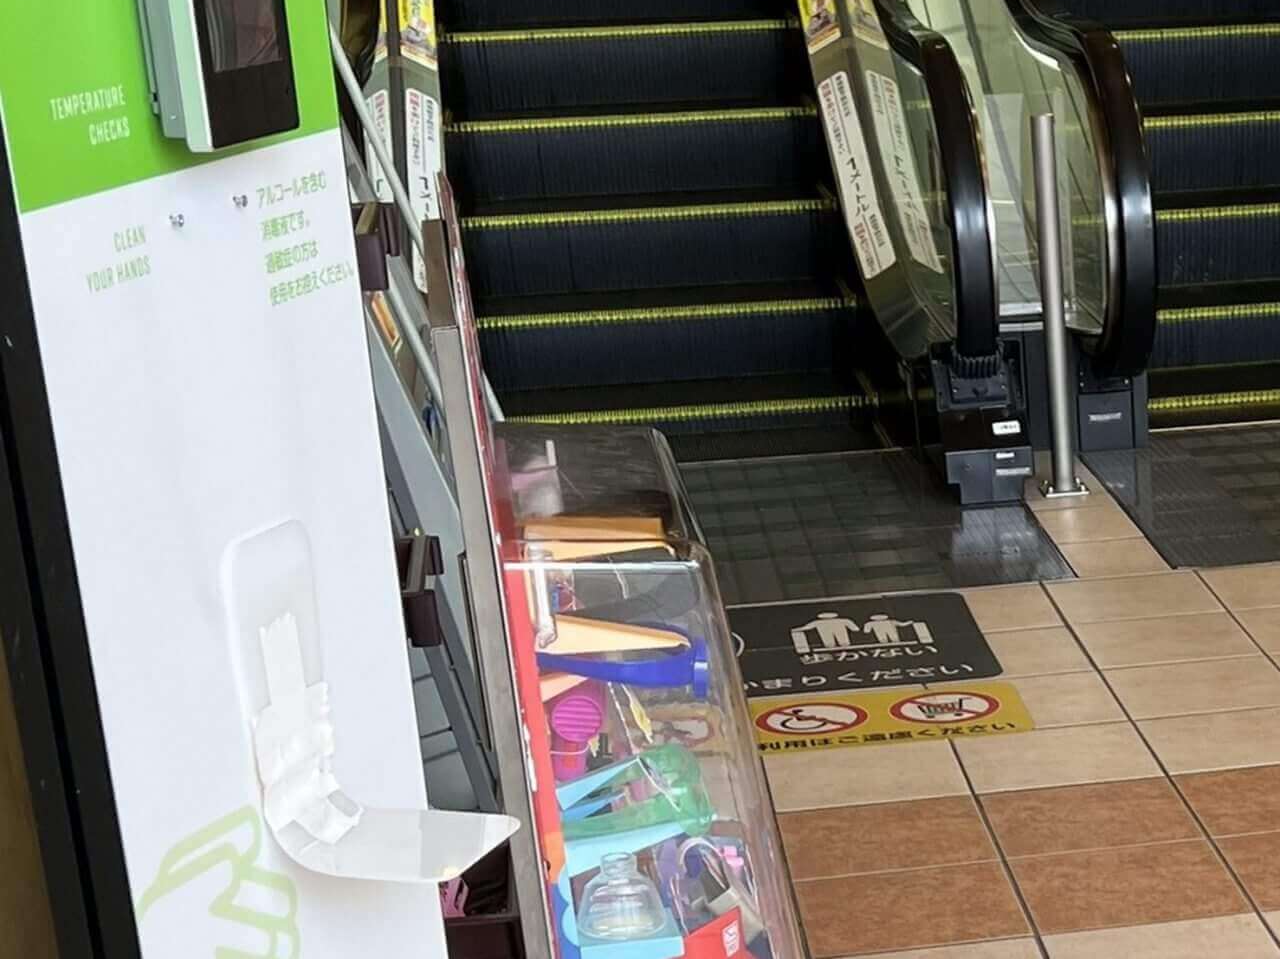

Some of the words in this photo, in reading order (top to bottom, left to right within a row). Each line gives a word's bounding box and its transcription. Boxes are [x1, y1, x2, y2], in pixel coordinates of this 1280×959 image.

[50, 84, 127, 121] TEMPERATURE
[88, 116, 131, 146] CHECKS
[113, 224, 147, 253] CLEAN
[86, 266, 115, 294] YOUR
[116, 255, 151, 283] HANDS
[799, 645, 938, 665] 歩かない
